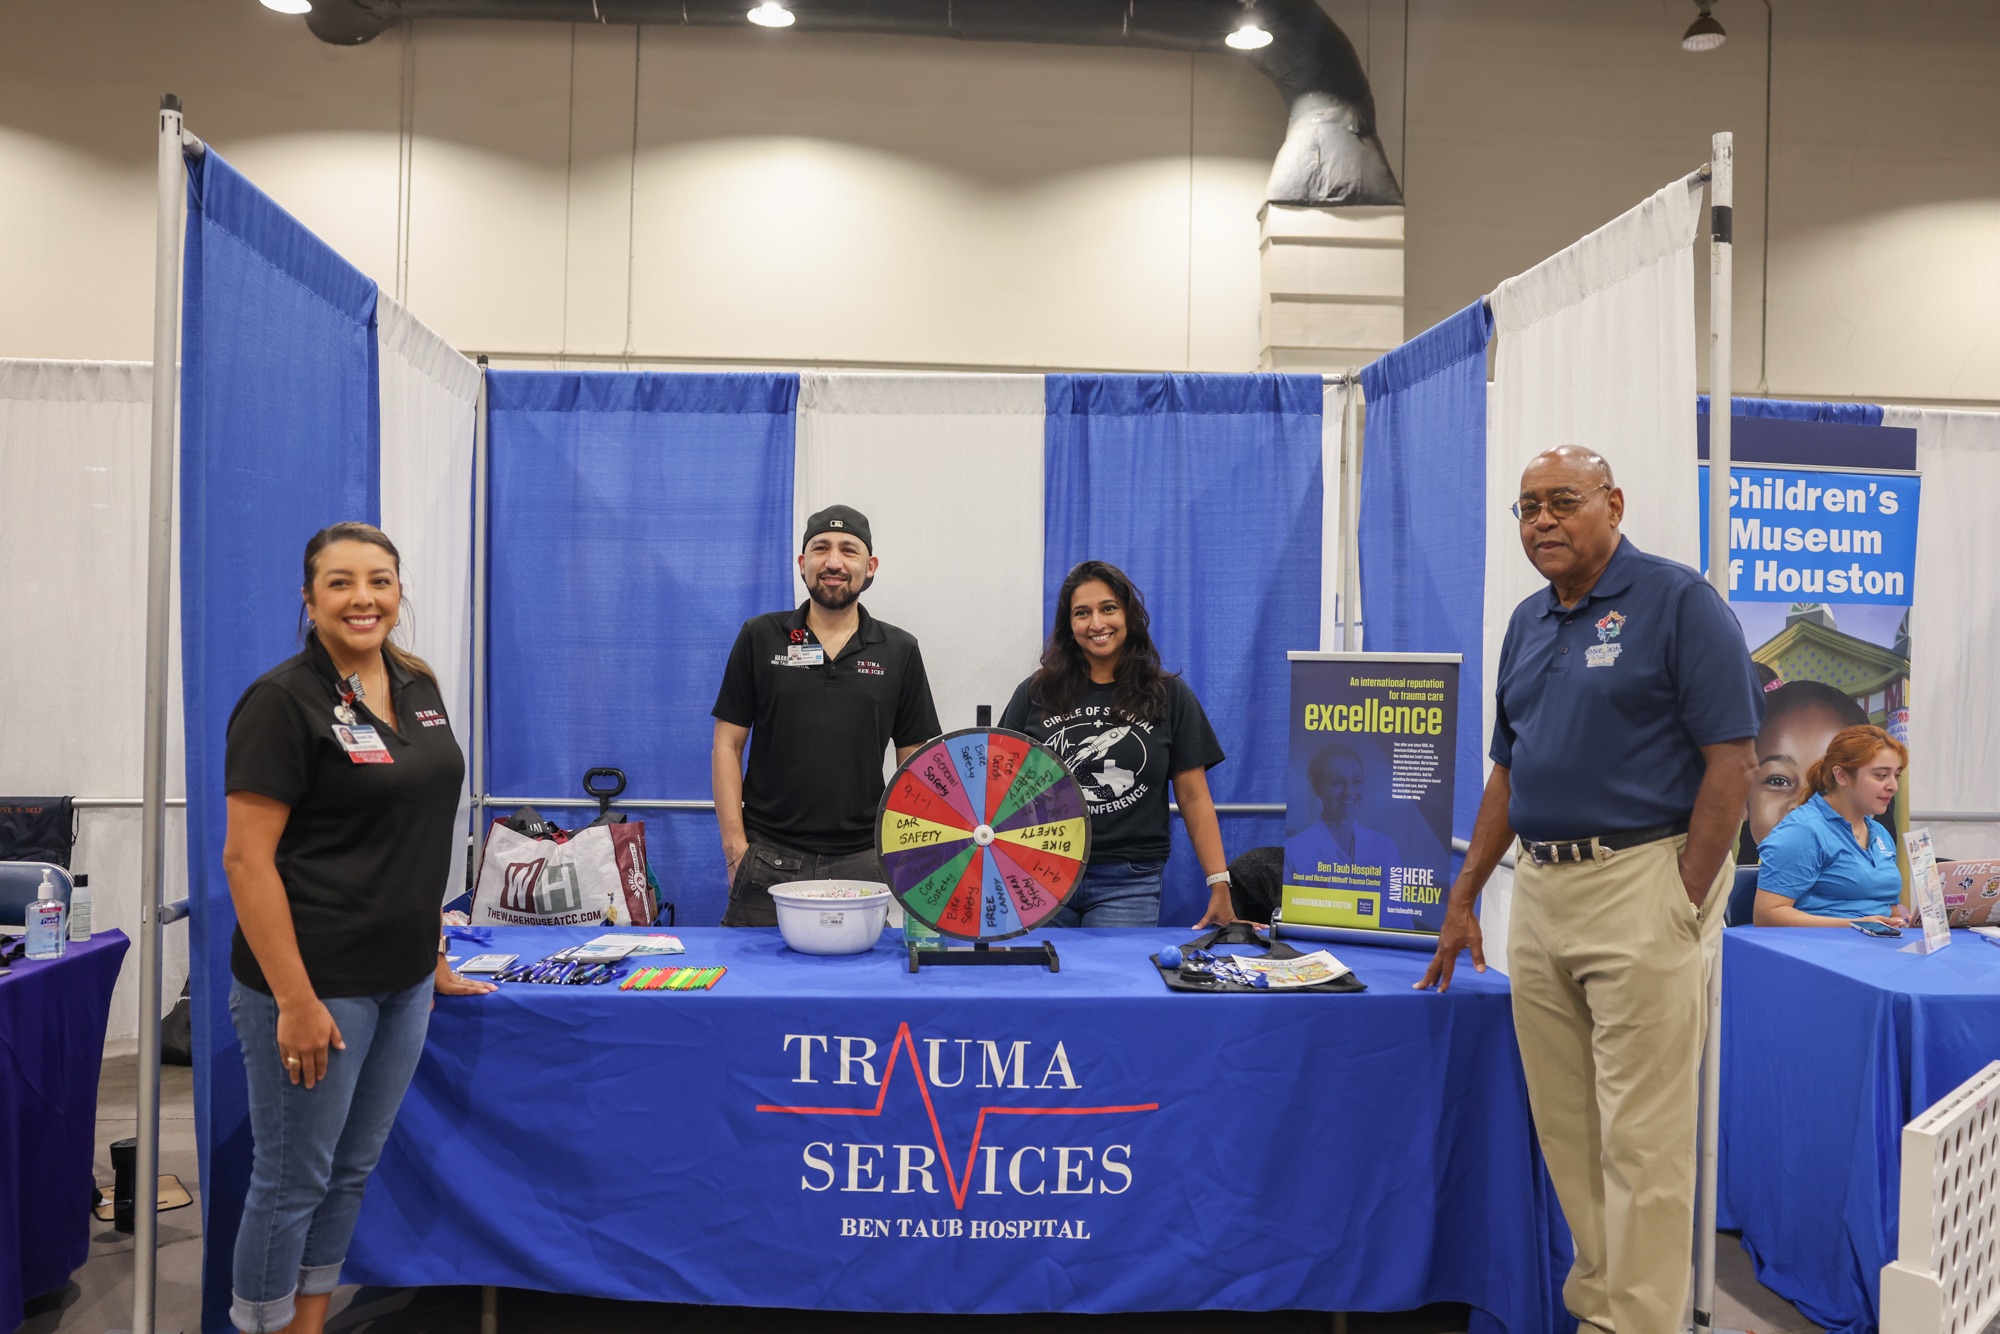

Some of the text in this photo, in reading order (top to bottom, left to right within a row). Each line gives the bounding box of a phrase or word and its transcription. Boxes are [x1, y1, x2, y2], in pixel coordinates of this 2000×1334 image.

[1730, 517, 1882, 554] Museum
[1754, 560, 1904, 595] Houston
[1350, 677, 1444, 689] An international reputation
[1389, 690, 1444, 701] for trauma care
[1043, 708, 1082, 728] CIRCLE
[1086, 706, 1100, 716] OF
[1304, 698, 1443, 735] excellence
[1087, 783, 1148, 815] NFERENCE
[897, 817, 920, 829] CAR
[1021, 825, 1066, 839] SAFETY
[899, 830, 942, 845] SAFETY
[1041, 841, 1071, 852] BIKE
[1317, 861, 1382, 877] Ben Taub Hospital
[1952, 863, 1991, 876] RICE
[1304, 874, 1313, 882] and
[1349, 877, 1365, 885] Trauma
[1389, 867, 1434, 902] ALWAYS HERE
[993, 878, 1008, 914] CANDY
[1402, 886, 1442, 905] READY
[986, 895, 997, 927] FREE
[1387, 906, 1423, 916] harrishealth.org
[783, 1022, 1083, 1090] TRAUMA
[801, 1141, 1132, 1209] SERVICES
[840, 1218, 1091, 1240] BEN TAUB HOSPITAL
